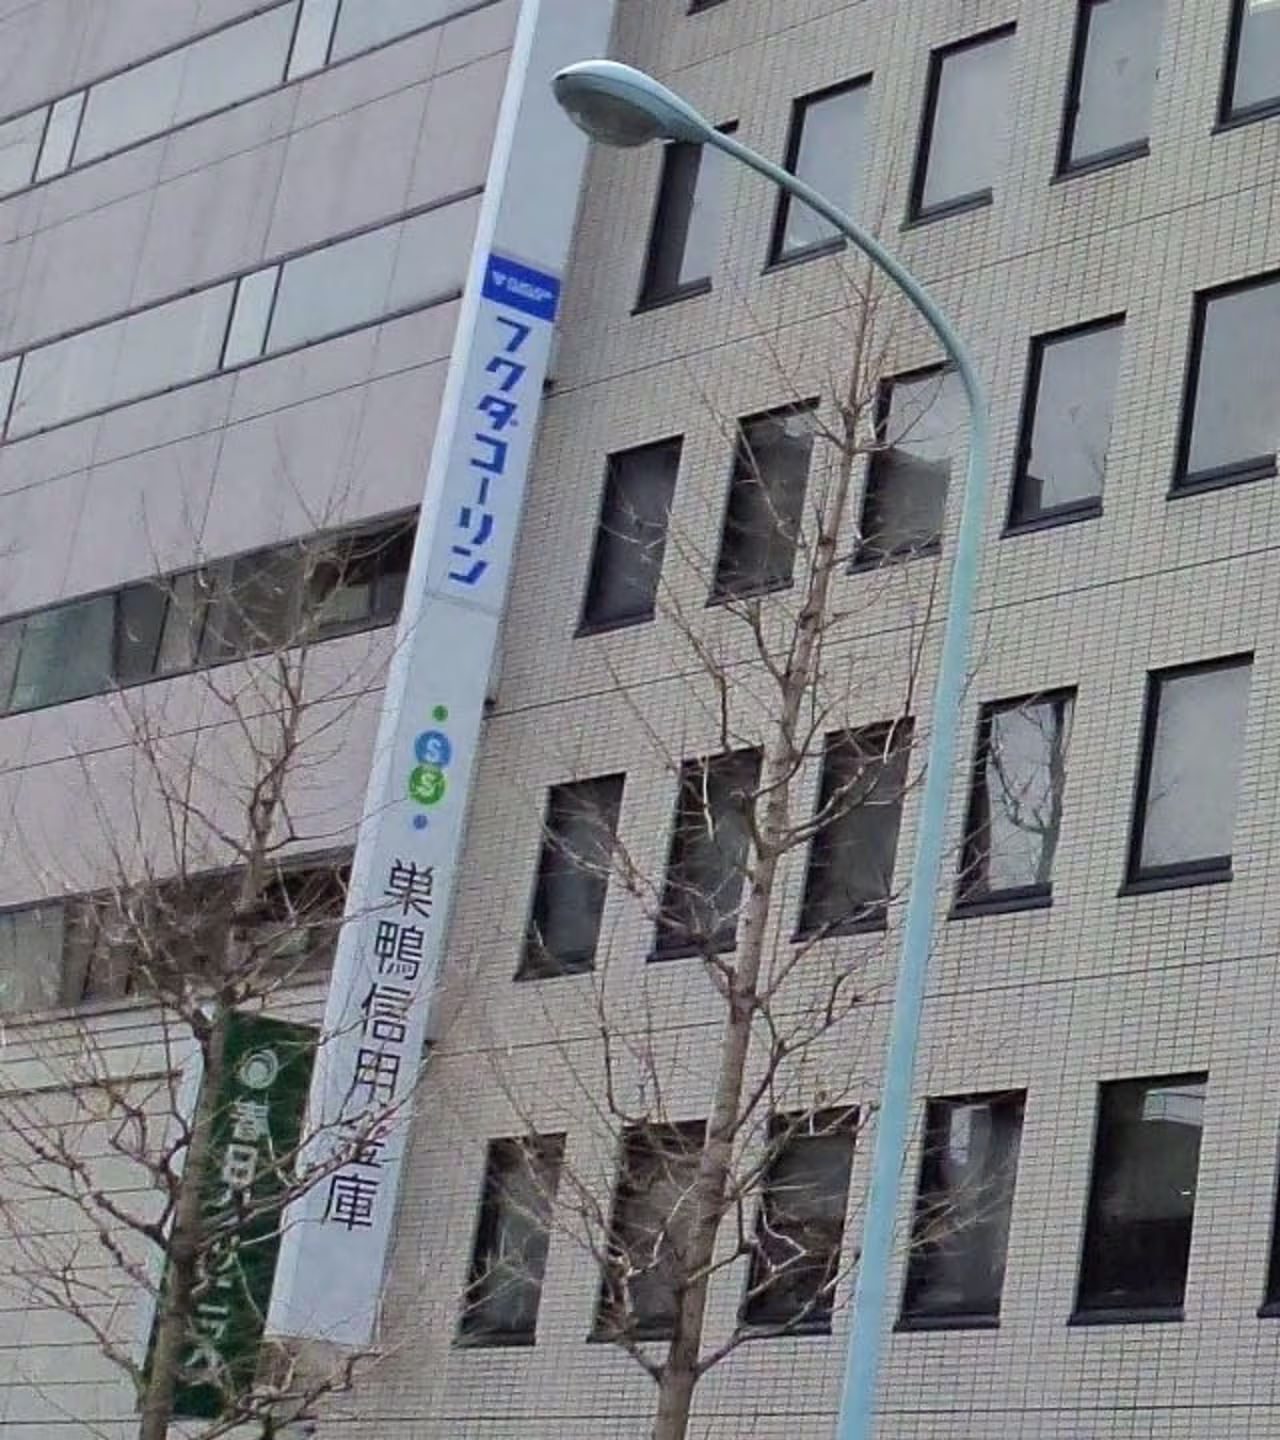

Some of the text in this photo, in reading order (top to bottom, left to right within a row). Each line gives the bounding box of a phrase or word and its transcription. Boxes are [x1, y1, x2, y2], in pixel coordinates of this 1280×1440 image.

[449, 315, 531, 585] フクダコーリン
[321, 858, 433, 1232] 巣鴨信用金庫
